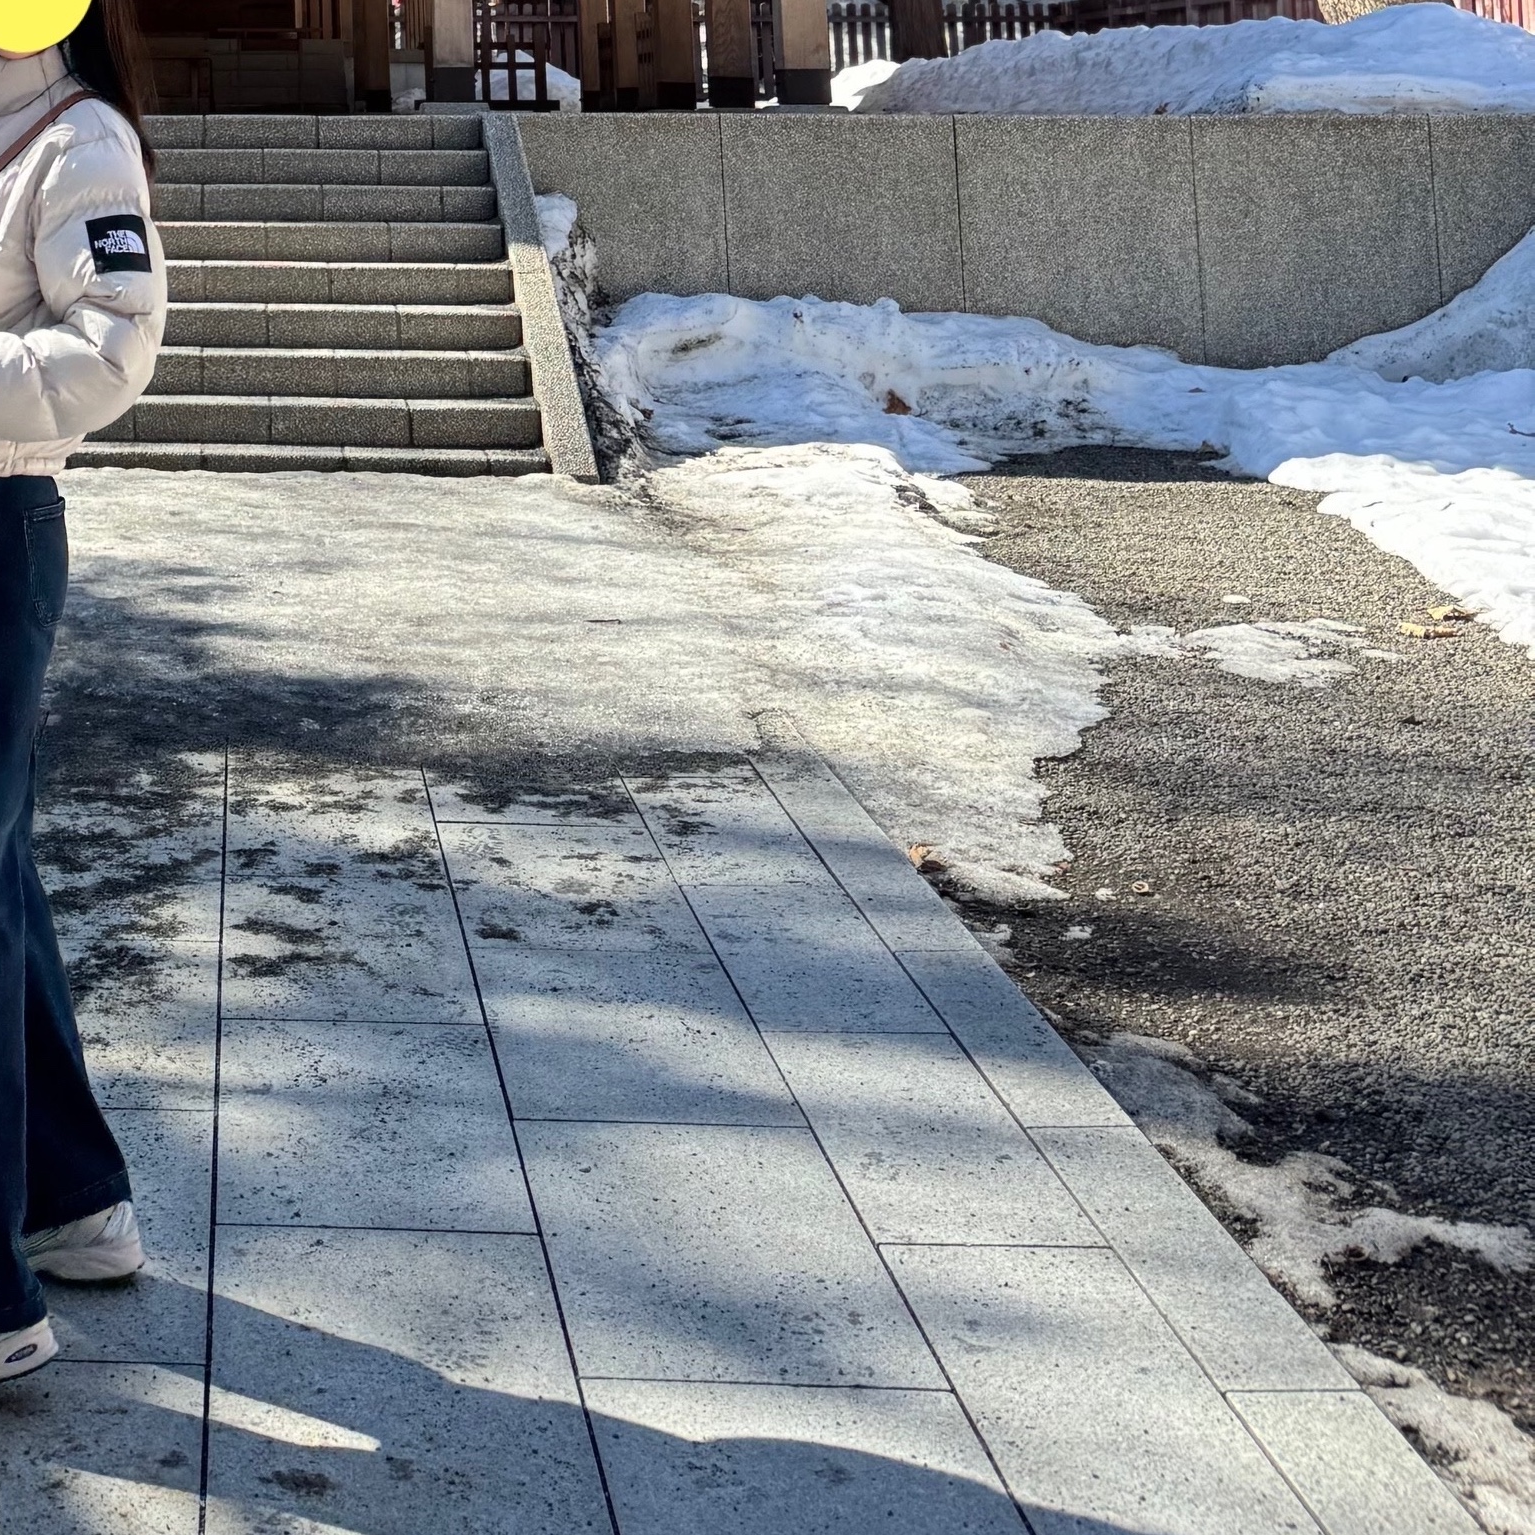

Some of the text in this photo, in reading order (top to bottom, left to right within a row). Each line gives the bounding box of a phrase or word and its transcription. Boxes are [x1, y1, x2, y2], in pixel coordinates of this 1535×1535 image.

[106, 230, 127, 238] THE
[94, 237, 128, 249] NORTH
[105, 245, 131, 254] FACE
